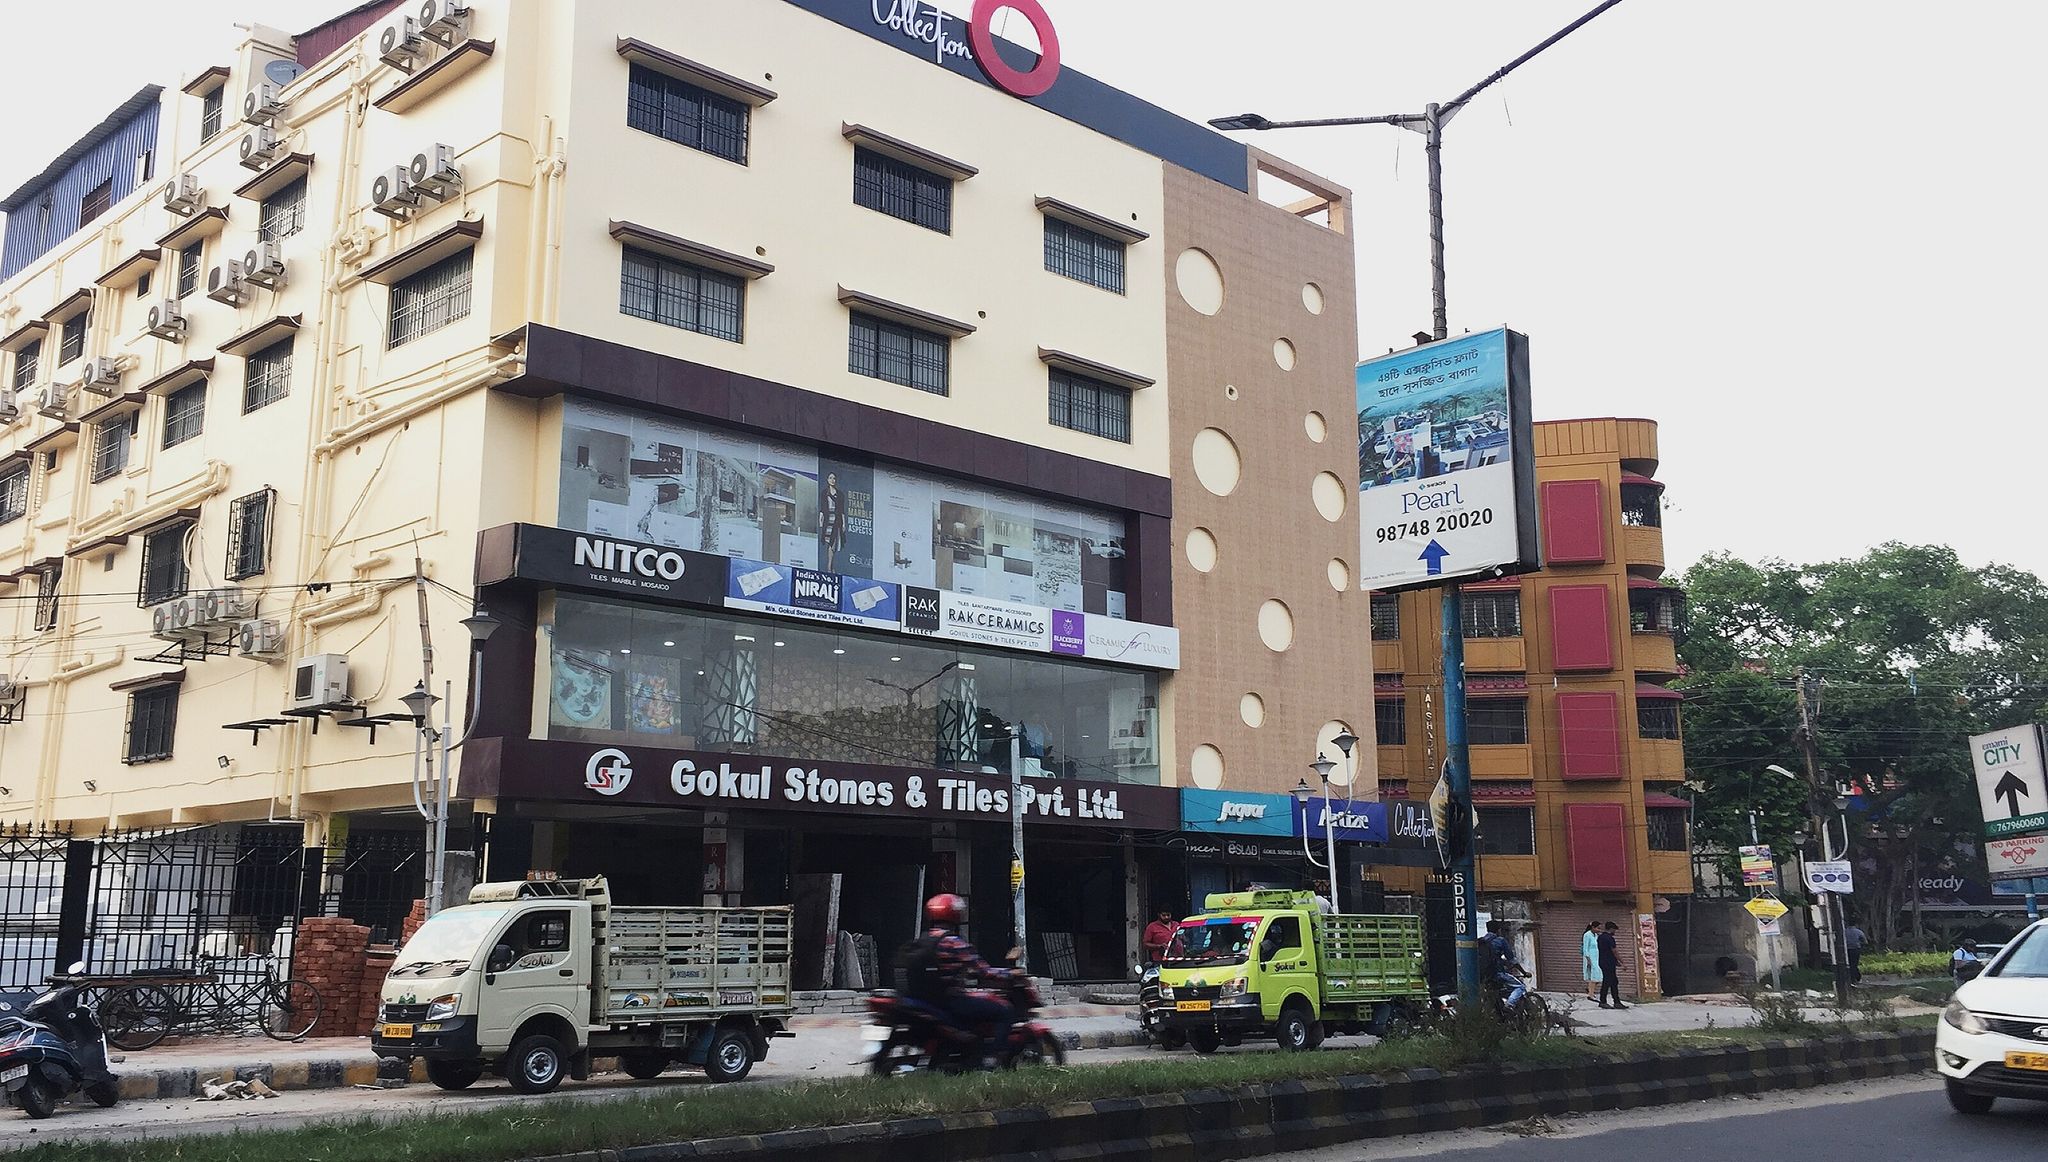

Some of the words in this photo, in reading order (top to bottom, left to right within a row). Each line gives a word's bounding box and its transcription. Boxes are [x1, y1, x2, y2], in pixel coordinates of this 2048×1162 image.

[847, 490, 871, 502] BETTER
[1401, 484, 1464, 514] Pearl
[848, 500, 865, 509] THAN
[847, 508, 873, 519] MARBLE
[848, 525, 873, 536] ASPECTS
[854, 517, 873, 528] EVERY
[1376, 520, 1430, 543] 98748
[1435, 508, 1493, 533] 20020
[574, 536, 685, 581] NITCO
[589, 573, 608, 582] TILES
[611, 576, 637, 587] MARBLE
[640, 581, 670, 591] MOSAICO
[796, 569, 820, 580] India's
[821, 574, 834, 583] No.
[794, 579, 839, 605] NIRALI
[908, 596, 937, 612] RAK
[778, 606, 796, 615] Gokul
[796, 608, 816, 618] Stones
[816, 611, 828, 620] and
[828, 613, 841, 621] Tiles
[908, 611, 938, 620] CERAMICS
[948, 608, 975, 624] RAK
[977, 613, 1045, 634] CERAMICS
[908, 627, 933, 636] SELECT
[970, 631, 993, 641] STONES
[1000, 637, 1015, 645] TILES
[1028, 640, 1039, 648] LTD
[1984, 743, 2021, 766] CITY
[670, 759, 772, 800] Gokul
[783, 766, 894, 807] Stones
[905, 775, 928, 808] &
[937, 778, 1009, 813] Tiles
[1019, 784, 1071, 817] Pvt.
[1077, 788, 1123, 820] Ltd.
[1996, 816, 2045, 832] 7679600600
[2005, 837, 2045, 848] PARKING
